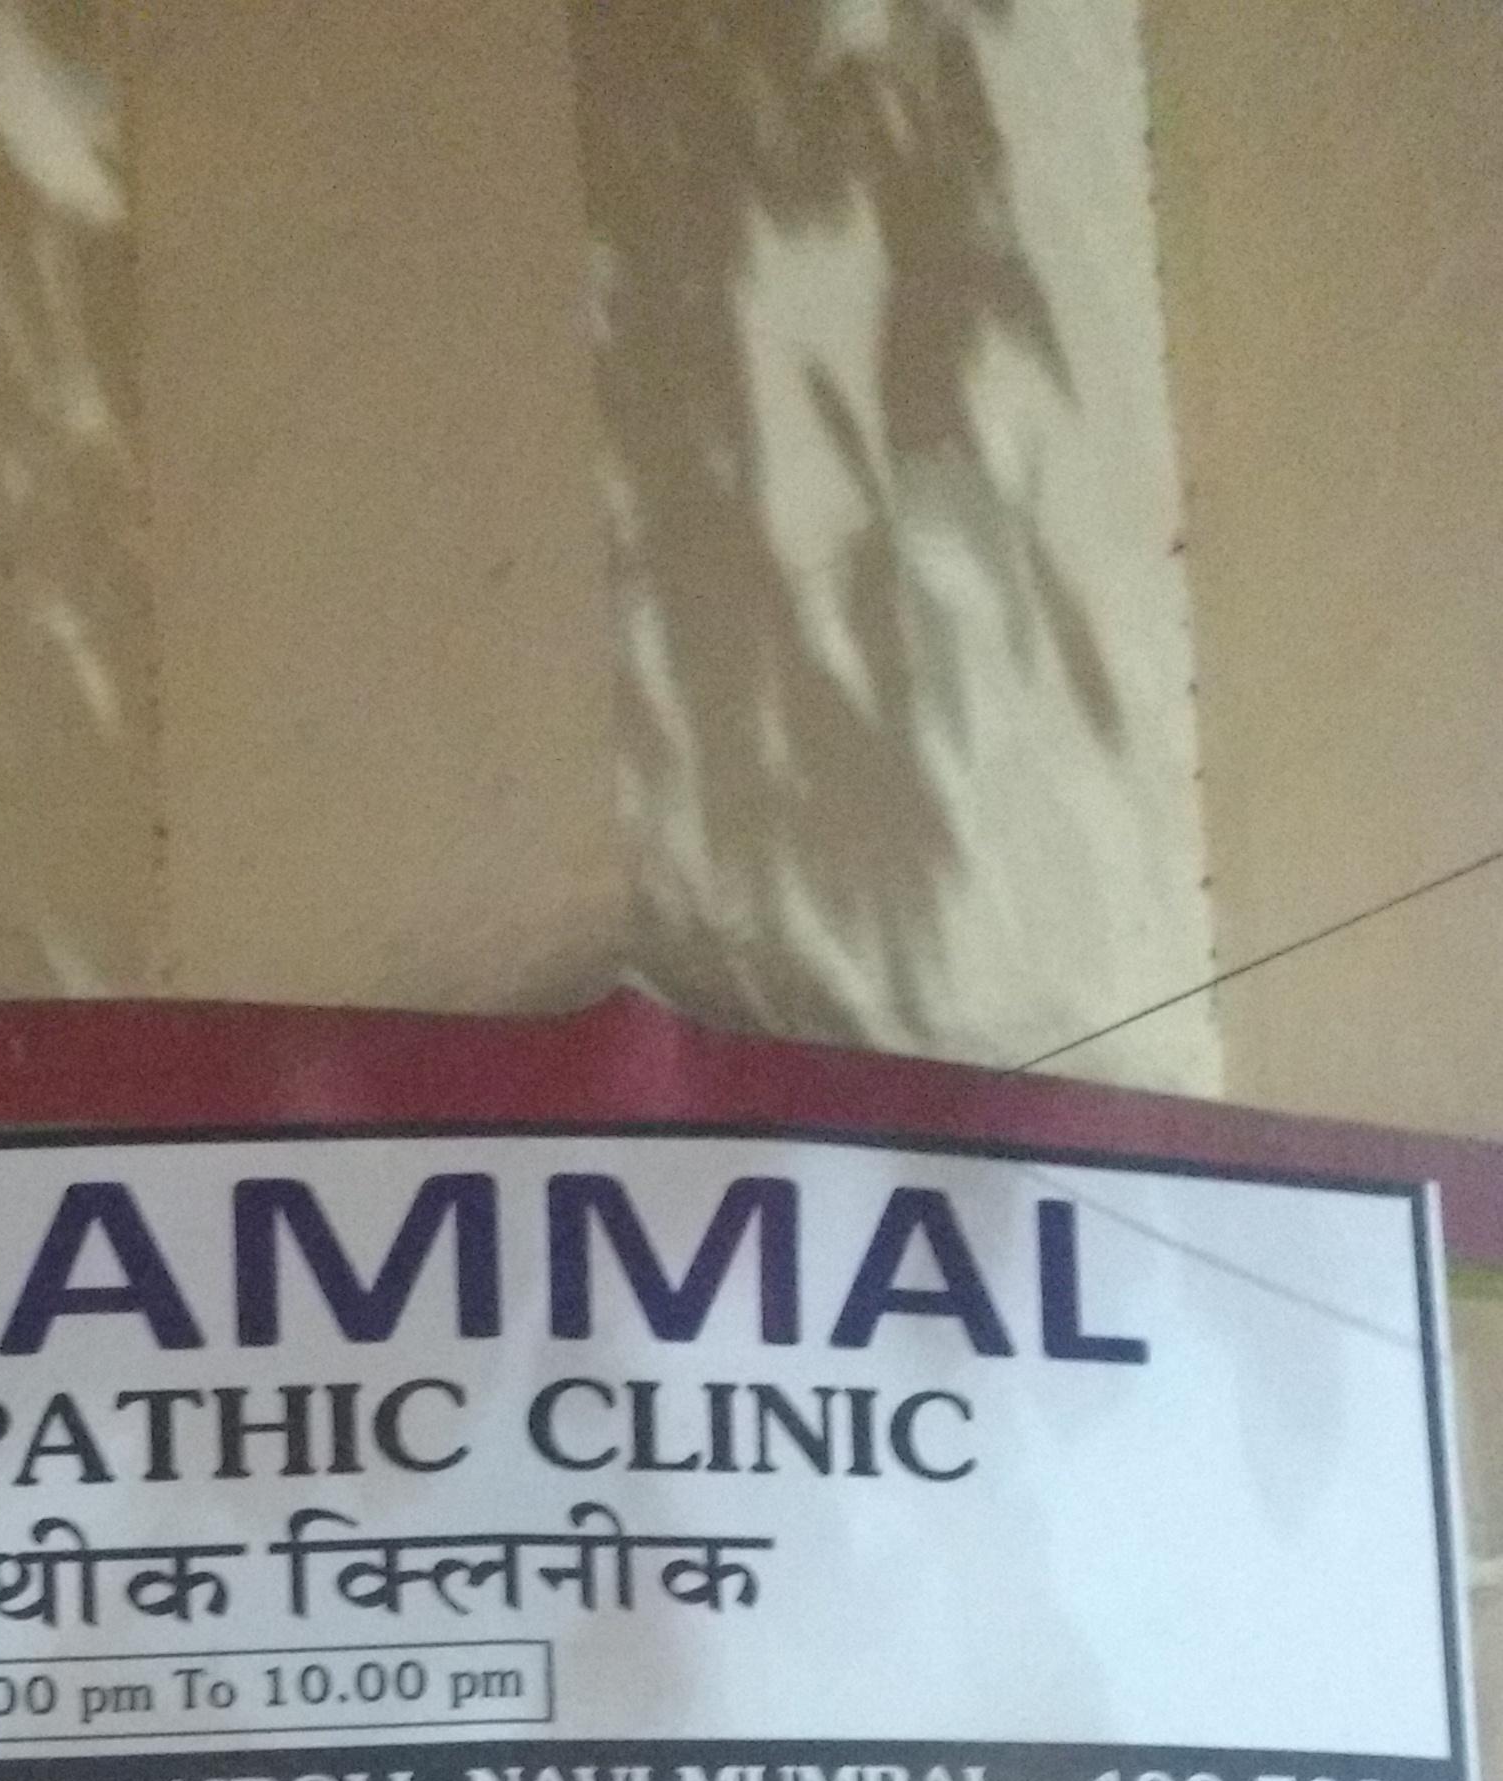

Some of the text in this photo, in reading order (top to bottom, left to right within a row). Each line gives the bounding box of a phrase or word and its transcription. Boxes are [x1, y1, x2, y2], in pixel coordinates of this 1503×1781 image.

[527, 1377, 978, 1482] CLINIC
[270, 1501, 774, 1620] क्लिनीक
[79, 1685, 154, 1724] pm
[173, 1666, 239, 1710] To
[263, 1659, 429, 1710] 10.00
[449, 1663, 525, 1707] pm
